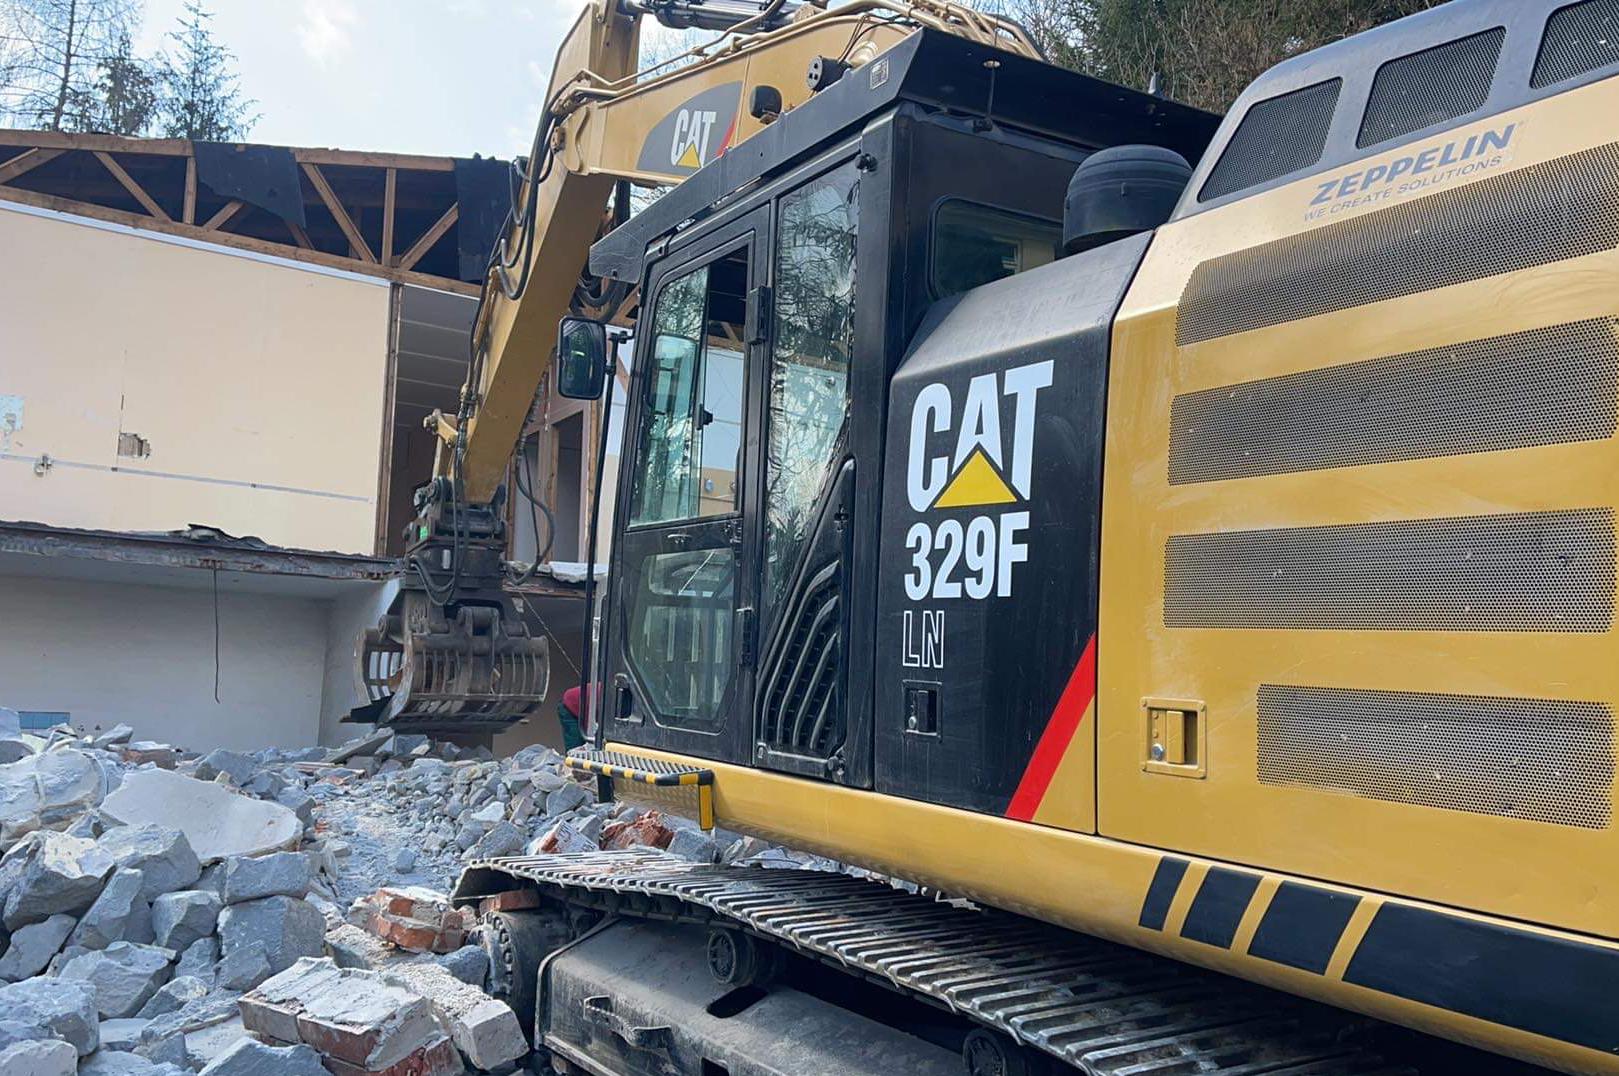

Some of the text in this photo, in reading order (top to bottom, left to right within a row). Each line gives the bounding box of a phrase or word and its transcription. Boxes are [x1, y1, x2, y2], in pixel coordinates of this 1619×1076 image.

[671, 109, 717, 168] CAT
[1309, 123, 1518, 206] ZEPPELIN
[1303, 155, 1502, 222] WE CREATE SOLUTIONS
[907, 359, 1055, 512] CAT
[904, 511, 1030, 601] 329F
[902, 610, 945, 669] LN
